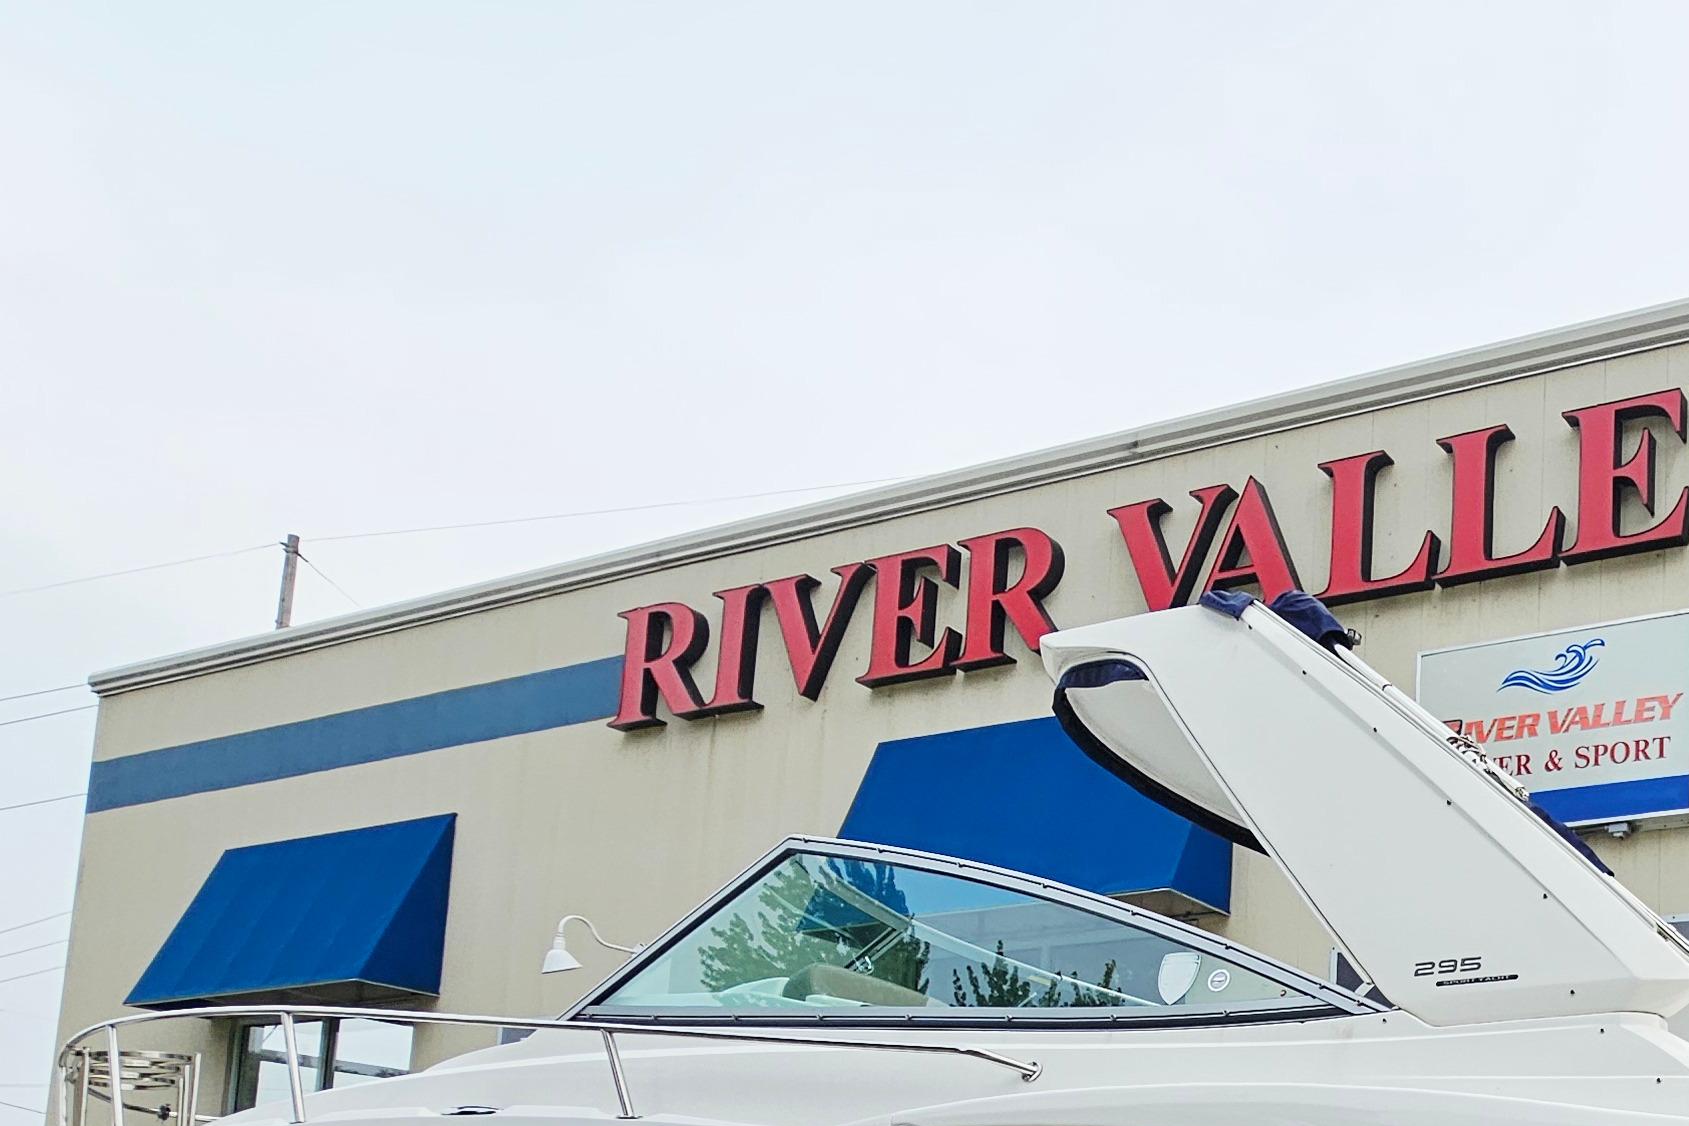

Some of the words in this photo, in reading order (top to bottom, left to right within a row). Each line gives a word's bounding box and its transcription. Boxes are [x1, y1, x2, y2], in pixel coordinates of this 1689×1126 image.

[607, 526, 1065, 731] RIVER
[1547, 692, 1684, 734] VALLEY
[1544, 750, 1564, 772] &
[1574, 736, 1672, 769] SPORT
[1414, 956, 1482, 977] 295
